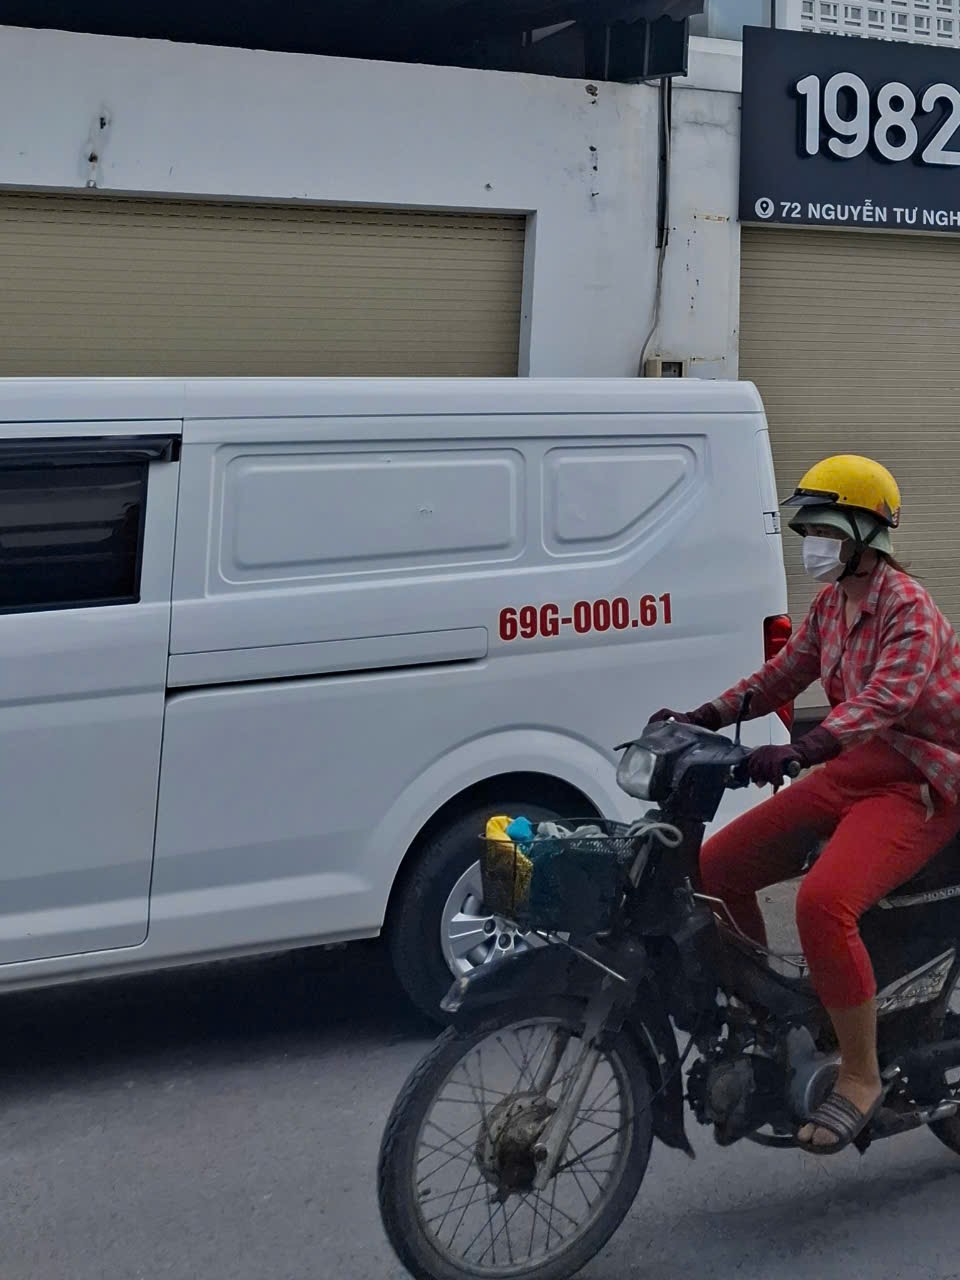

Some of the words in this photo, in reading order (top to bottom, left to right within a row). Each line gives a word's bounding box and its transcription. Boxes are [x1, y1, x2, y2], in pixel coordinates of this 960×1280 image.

[780, 201, 802, 218] 72
[807, 199, 888, 222] NGUYỄN
[892, 206, 919, 224] TƯ
[498, 592, 672, 642] 69G-000.61
